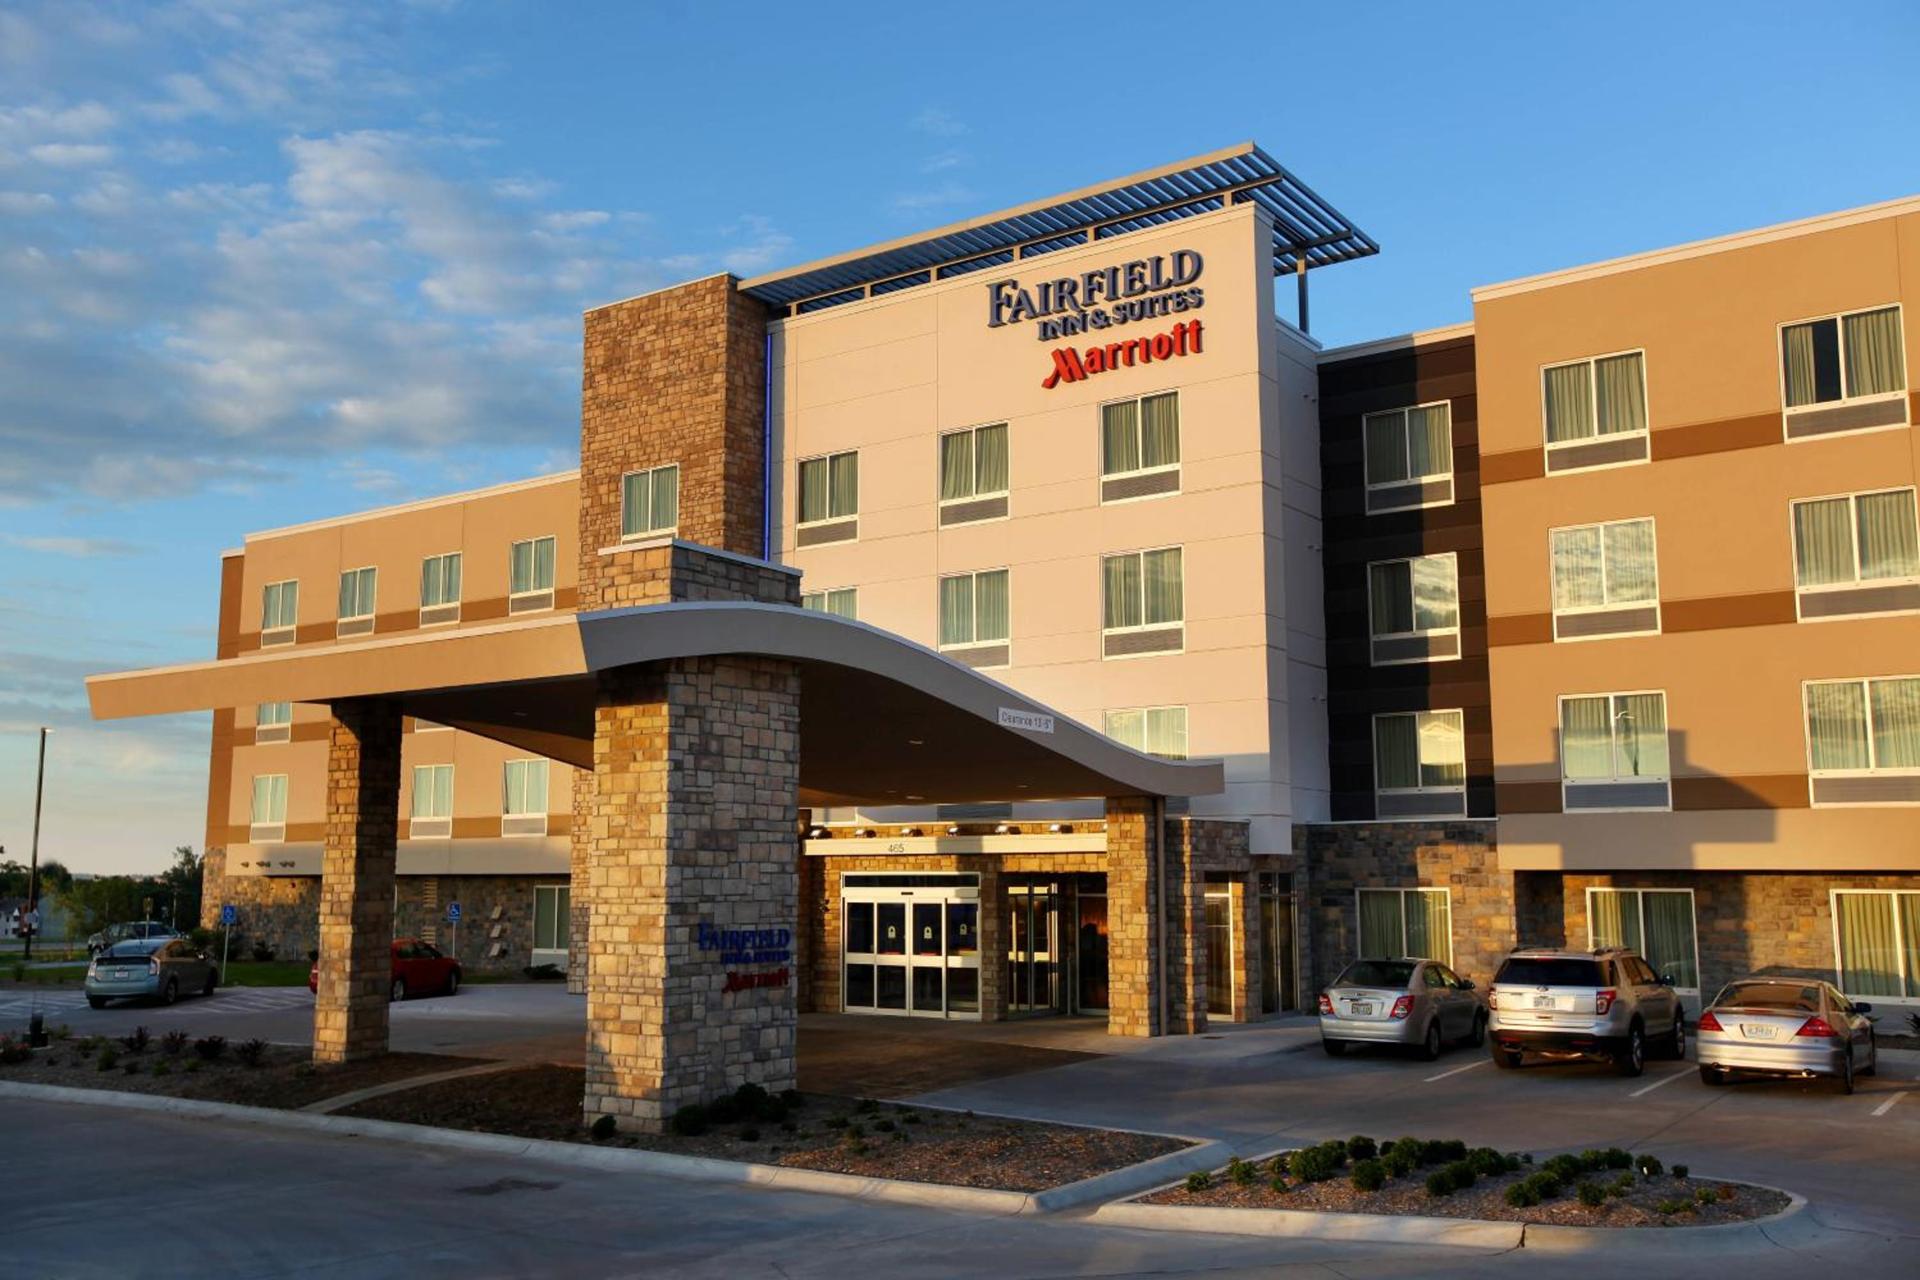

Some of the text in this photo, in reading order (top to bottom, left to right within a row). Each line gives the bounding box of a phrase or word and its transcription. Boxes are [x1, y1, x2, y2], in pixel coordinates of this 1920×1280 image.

[986, 249, 1204, 328] FAIRFIELD
[1112, 287, 1205, 324] SUITES
[1041, 318, 1204, 389] Marriott
